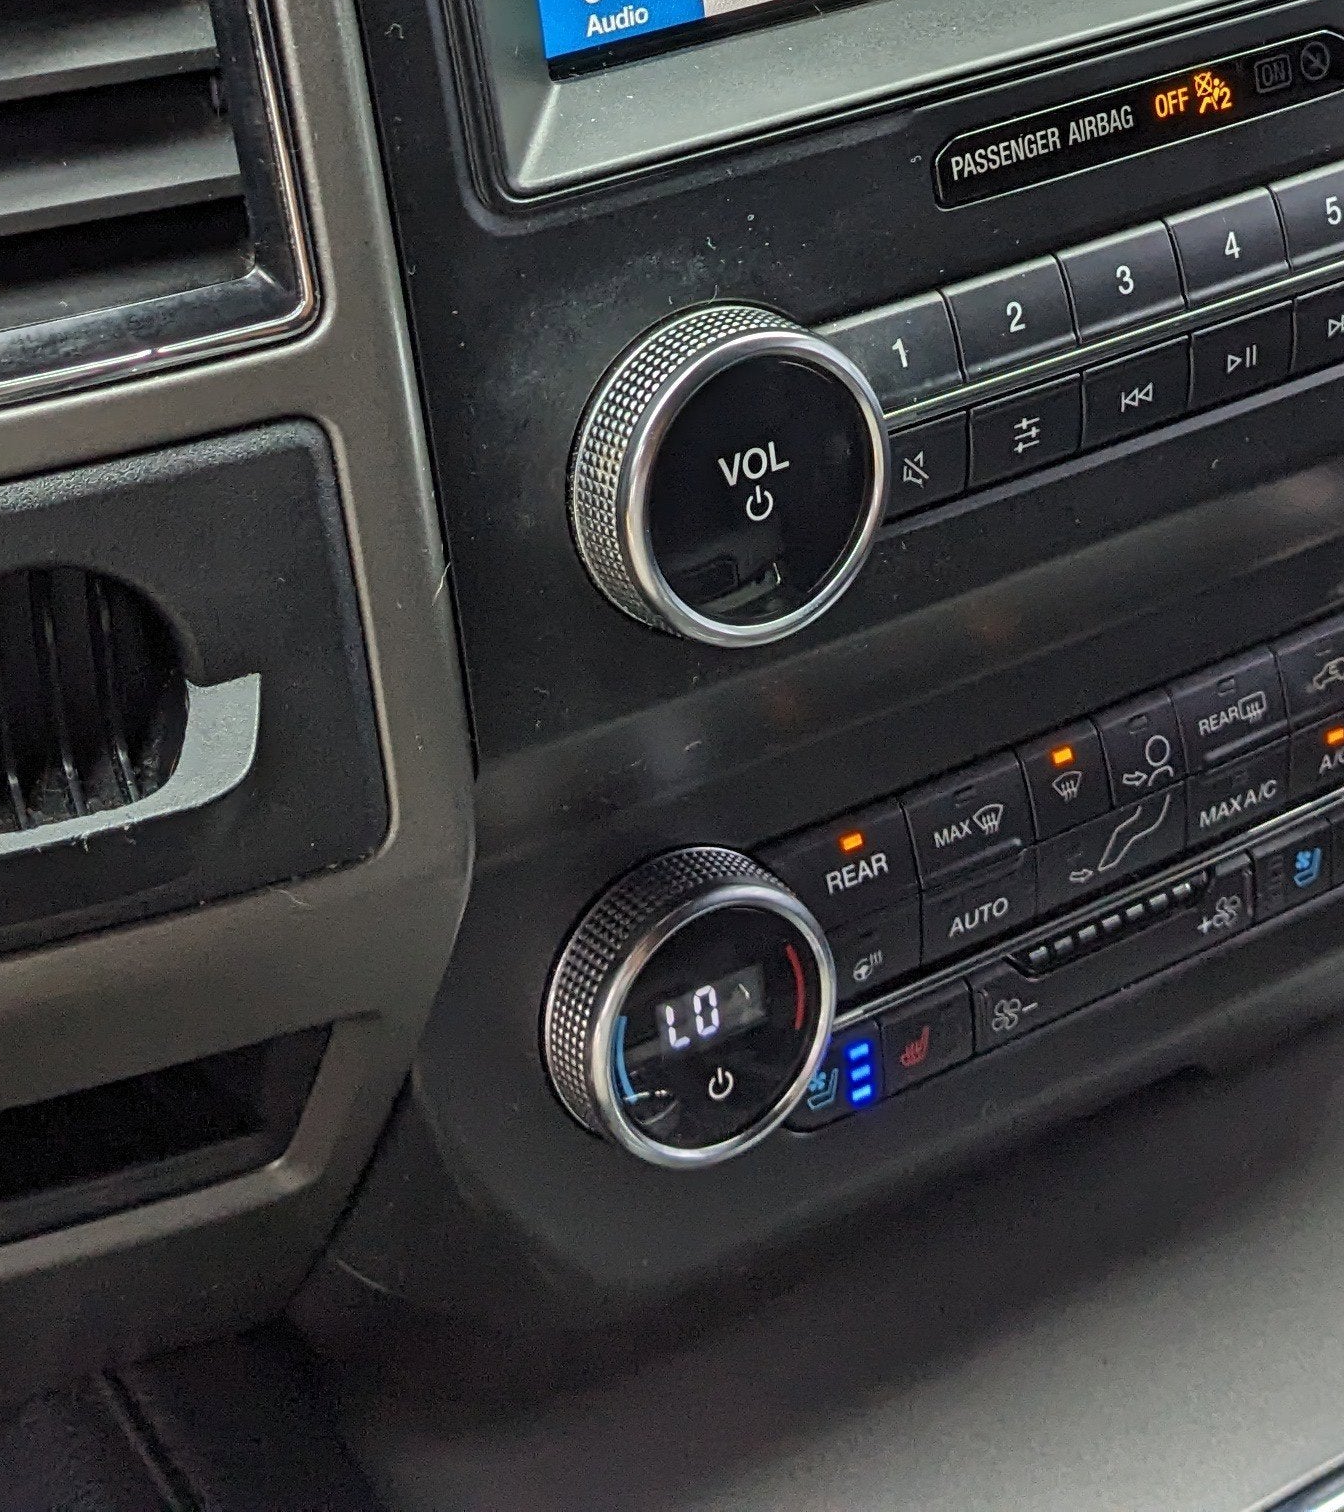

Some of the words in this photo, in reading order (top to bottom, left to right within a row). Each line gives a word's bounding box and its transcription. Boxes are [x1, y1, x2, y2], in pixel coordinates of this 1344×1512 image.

[585, 1, 649, 39] Audio
[1154, 86, 1190, 119] OFF
[951, 126, 1061, 181] PASSENGER
[1067, 105, 1134, 147] AIRBAG
[1324, 195, 1342, 228] 5
[1223, 230, 1242, 262] 4
[1114, 265, 1134, 296] 3
[1006, 301, 1026, 333] 2
[892, 337, 909, 369] 1
[717, 441, 791, 487] VOL
[1197, 705, 1241, 738] REAR
[1197, 792, 1243, 830] MAX
[1242, 777, 1278, 814] A/C
[932, 818, 973, 851] MAX
[824, 851, 890, 893] REAR
[946, 895, 1009, 941] AUTO
[664, 985, 721, 1049] LO
